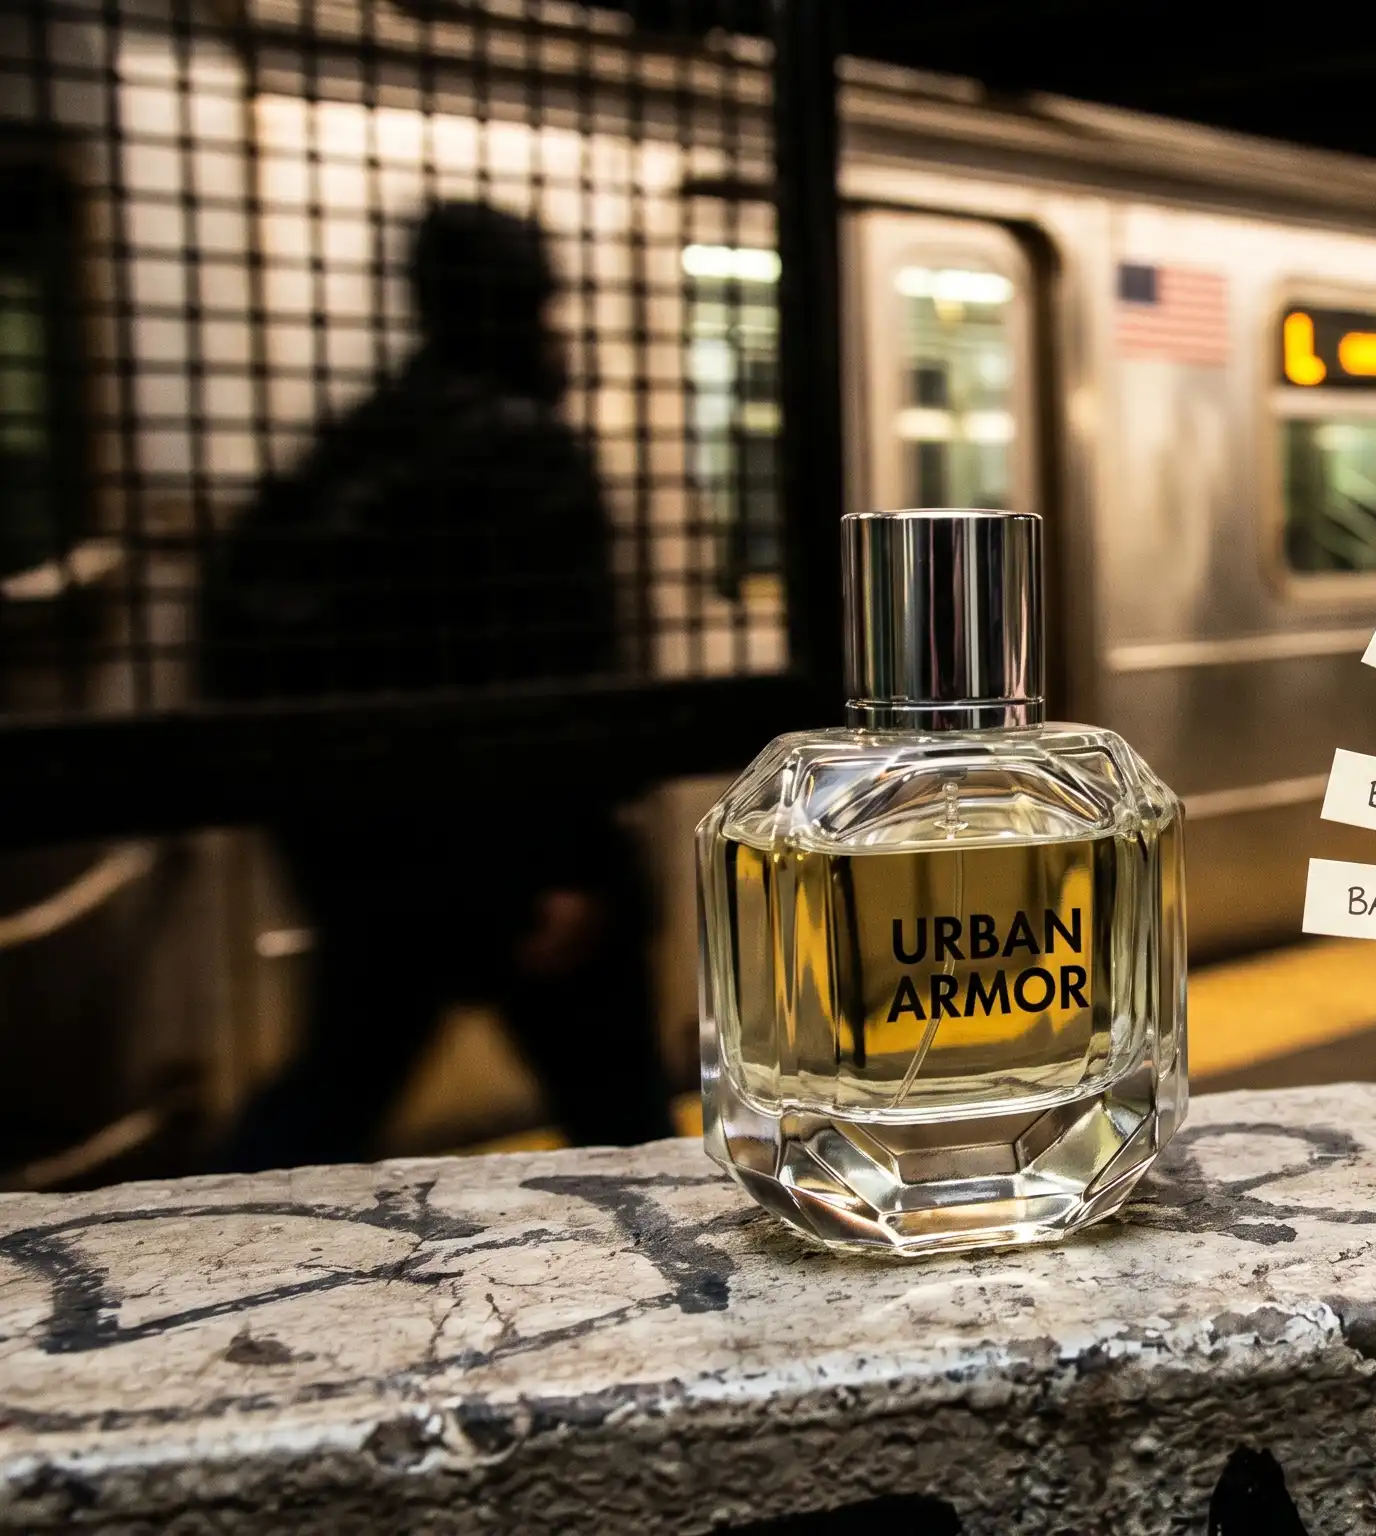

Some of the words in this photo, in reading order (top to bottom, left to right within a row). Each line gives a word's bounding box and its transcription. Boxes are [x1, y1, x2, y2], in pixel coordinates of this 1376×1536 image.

[1284, 312, 1326, 386] L
[892, 908, 1082, 964] URBAN
[887, 965, 1090, 1023] ARMOR
